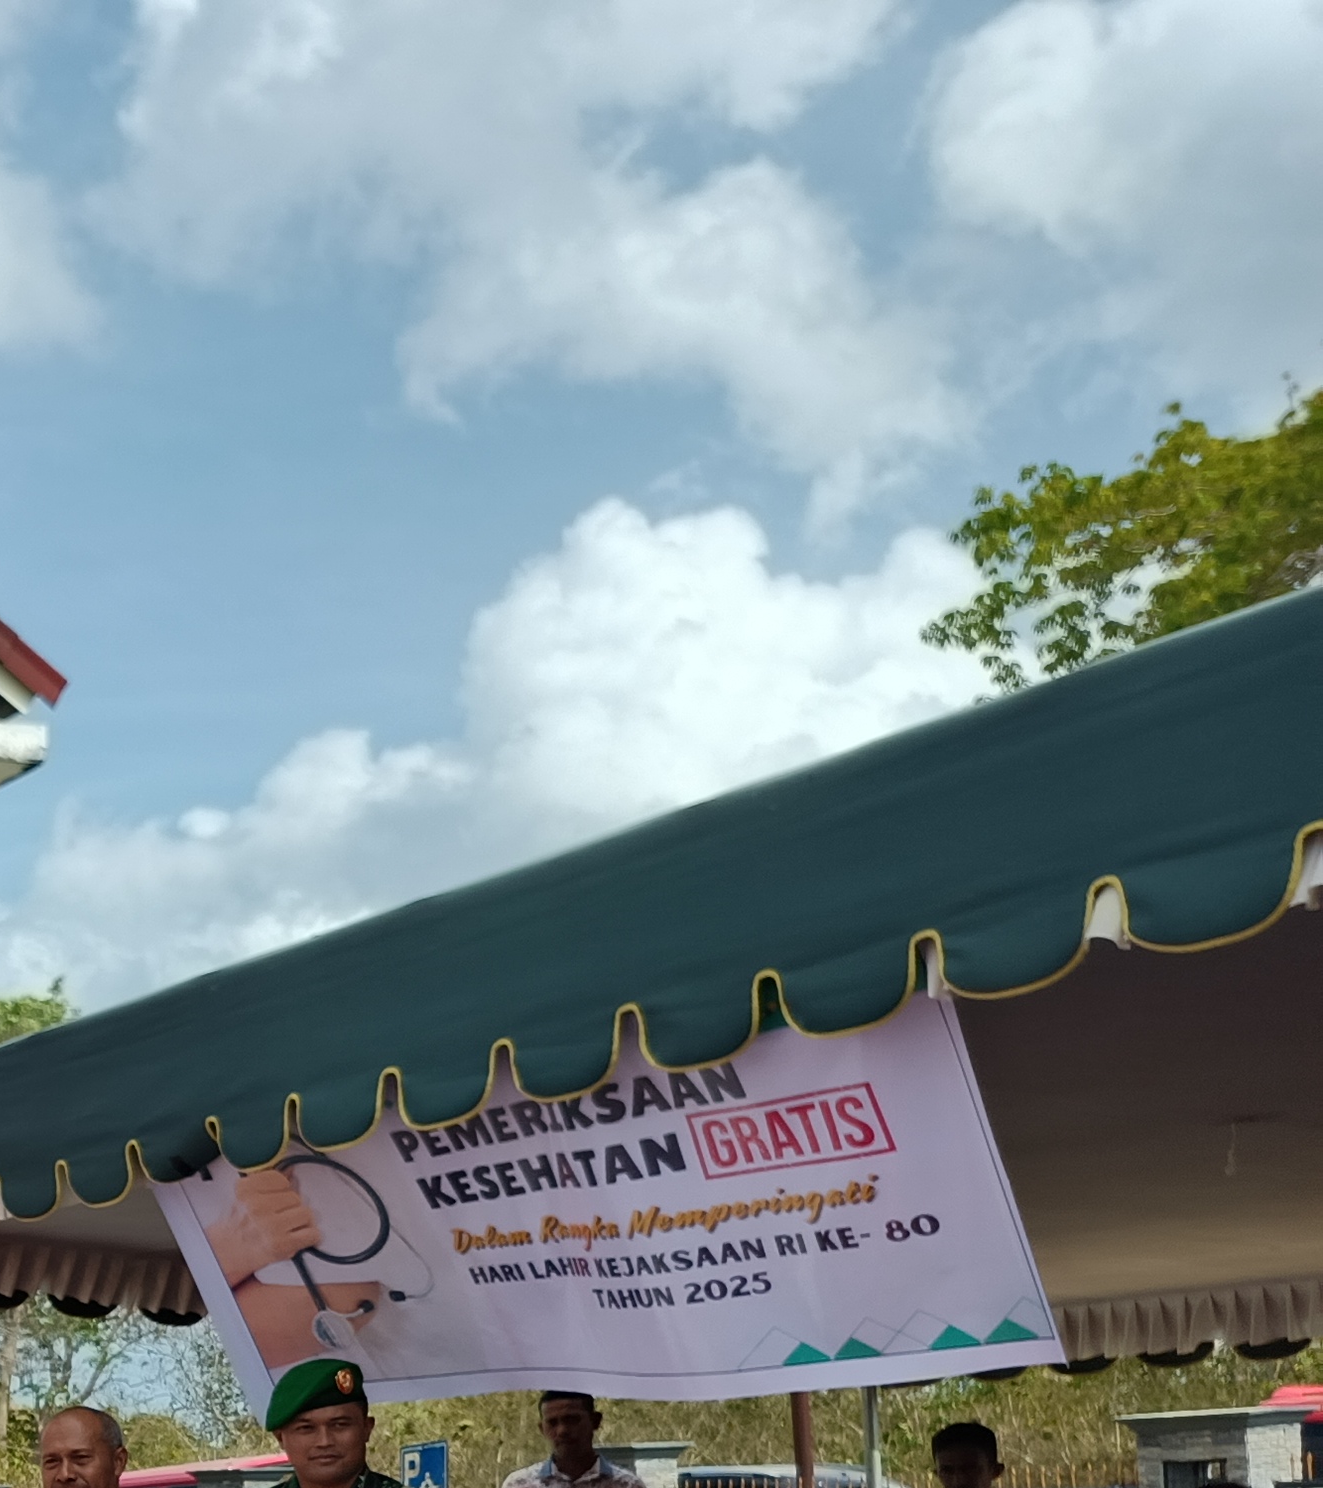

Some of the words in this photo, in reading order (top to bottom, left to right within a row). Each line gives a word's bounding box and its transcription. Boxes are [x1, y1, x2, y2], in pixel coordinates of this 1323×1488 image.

[390, 1062, 747, 1163] PEMERIKSAAN
[701, 1095, 875, 1168] GRATIS
[416, 1133, 687, 1209] KESEHATAN
[451, 1224, 533, 1255] Dalam
[539, 1214, 621, 1252] Rangka
[627, 1174, 879, 1239] Memperingati
[469, 1265, 526, 1284] HARI
[527, 1257, 592, 1280] LAHIR
[594, 1237, 767, 1279] KEJAKSAAN
[774, 1232, 808, 1257] RI
[814, 1227, 871, 1252] KE-
[885, 1213, 941, 1242] 80
[593, 1287, 675, 1310] TAHUN
[684, 1271, 772, 1304] 2025
